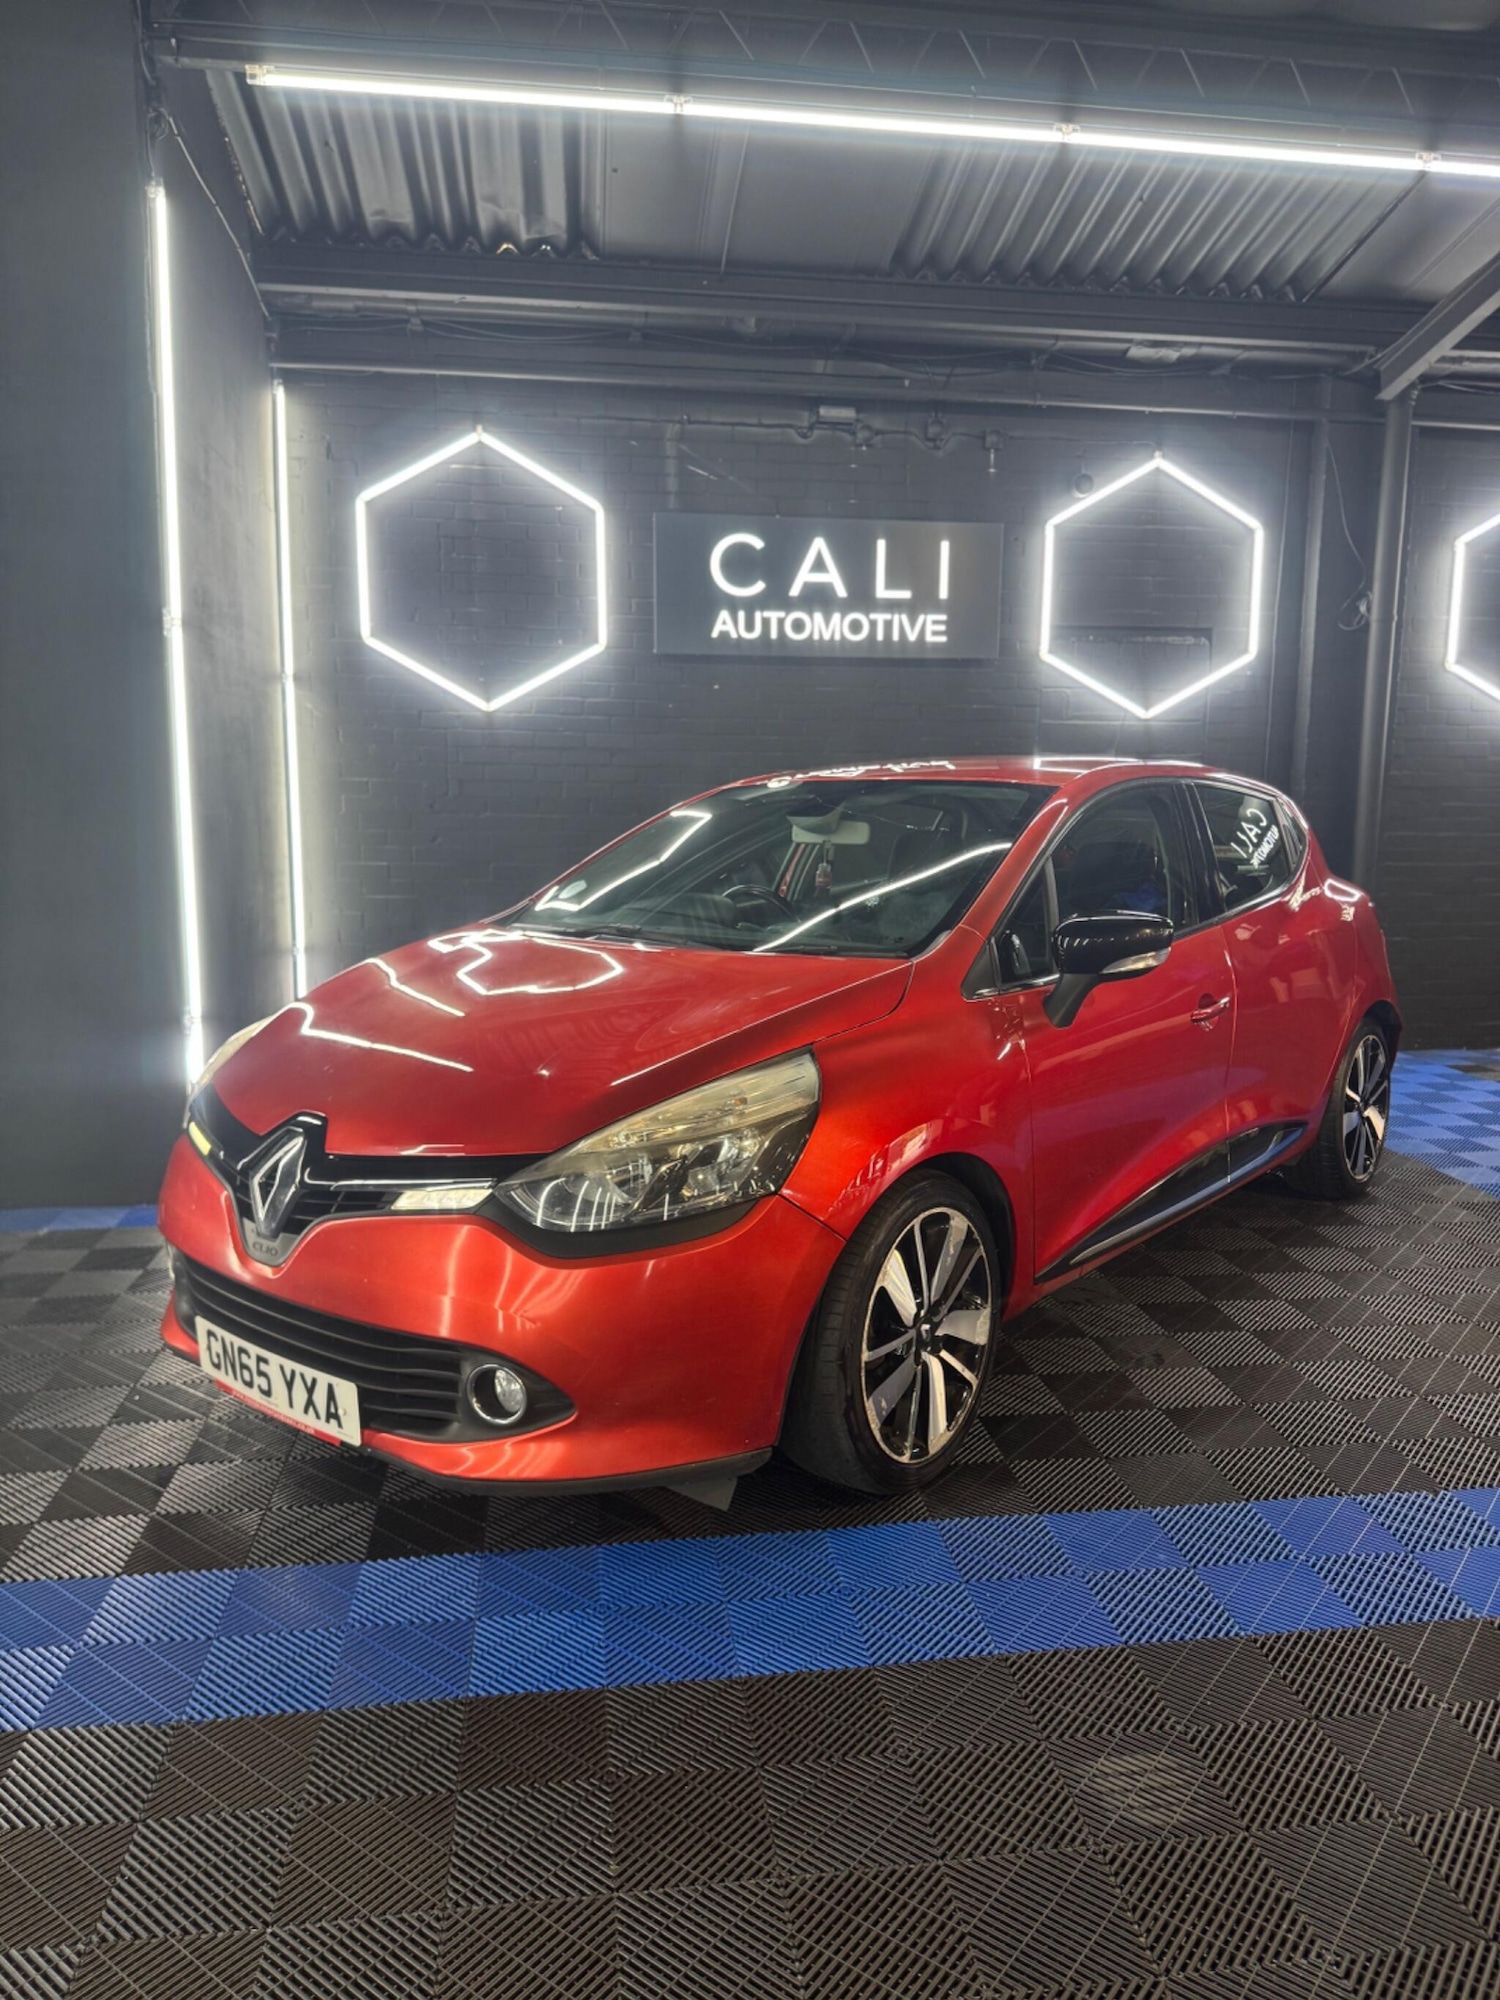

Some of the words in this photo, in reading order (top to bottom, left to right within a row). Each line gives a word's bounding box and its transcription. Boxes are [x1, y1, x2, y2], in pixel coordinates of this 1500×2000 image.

[710, 532, 950, 600] CALI
[711, 610, 947, 643] AUTOMOTIVE
[252, 1241, 278, 1256] CLIO
[206, 1329, 272, 1398] GN65
[279, 1364, 343, 1429] YXA
